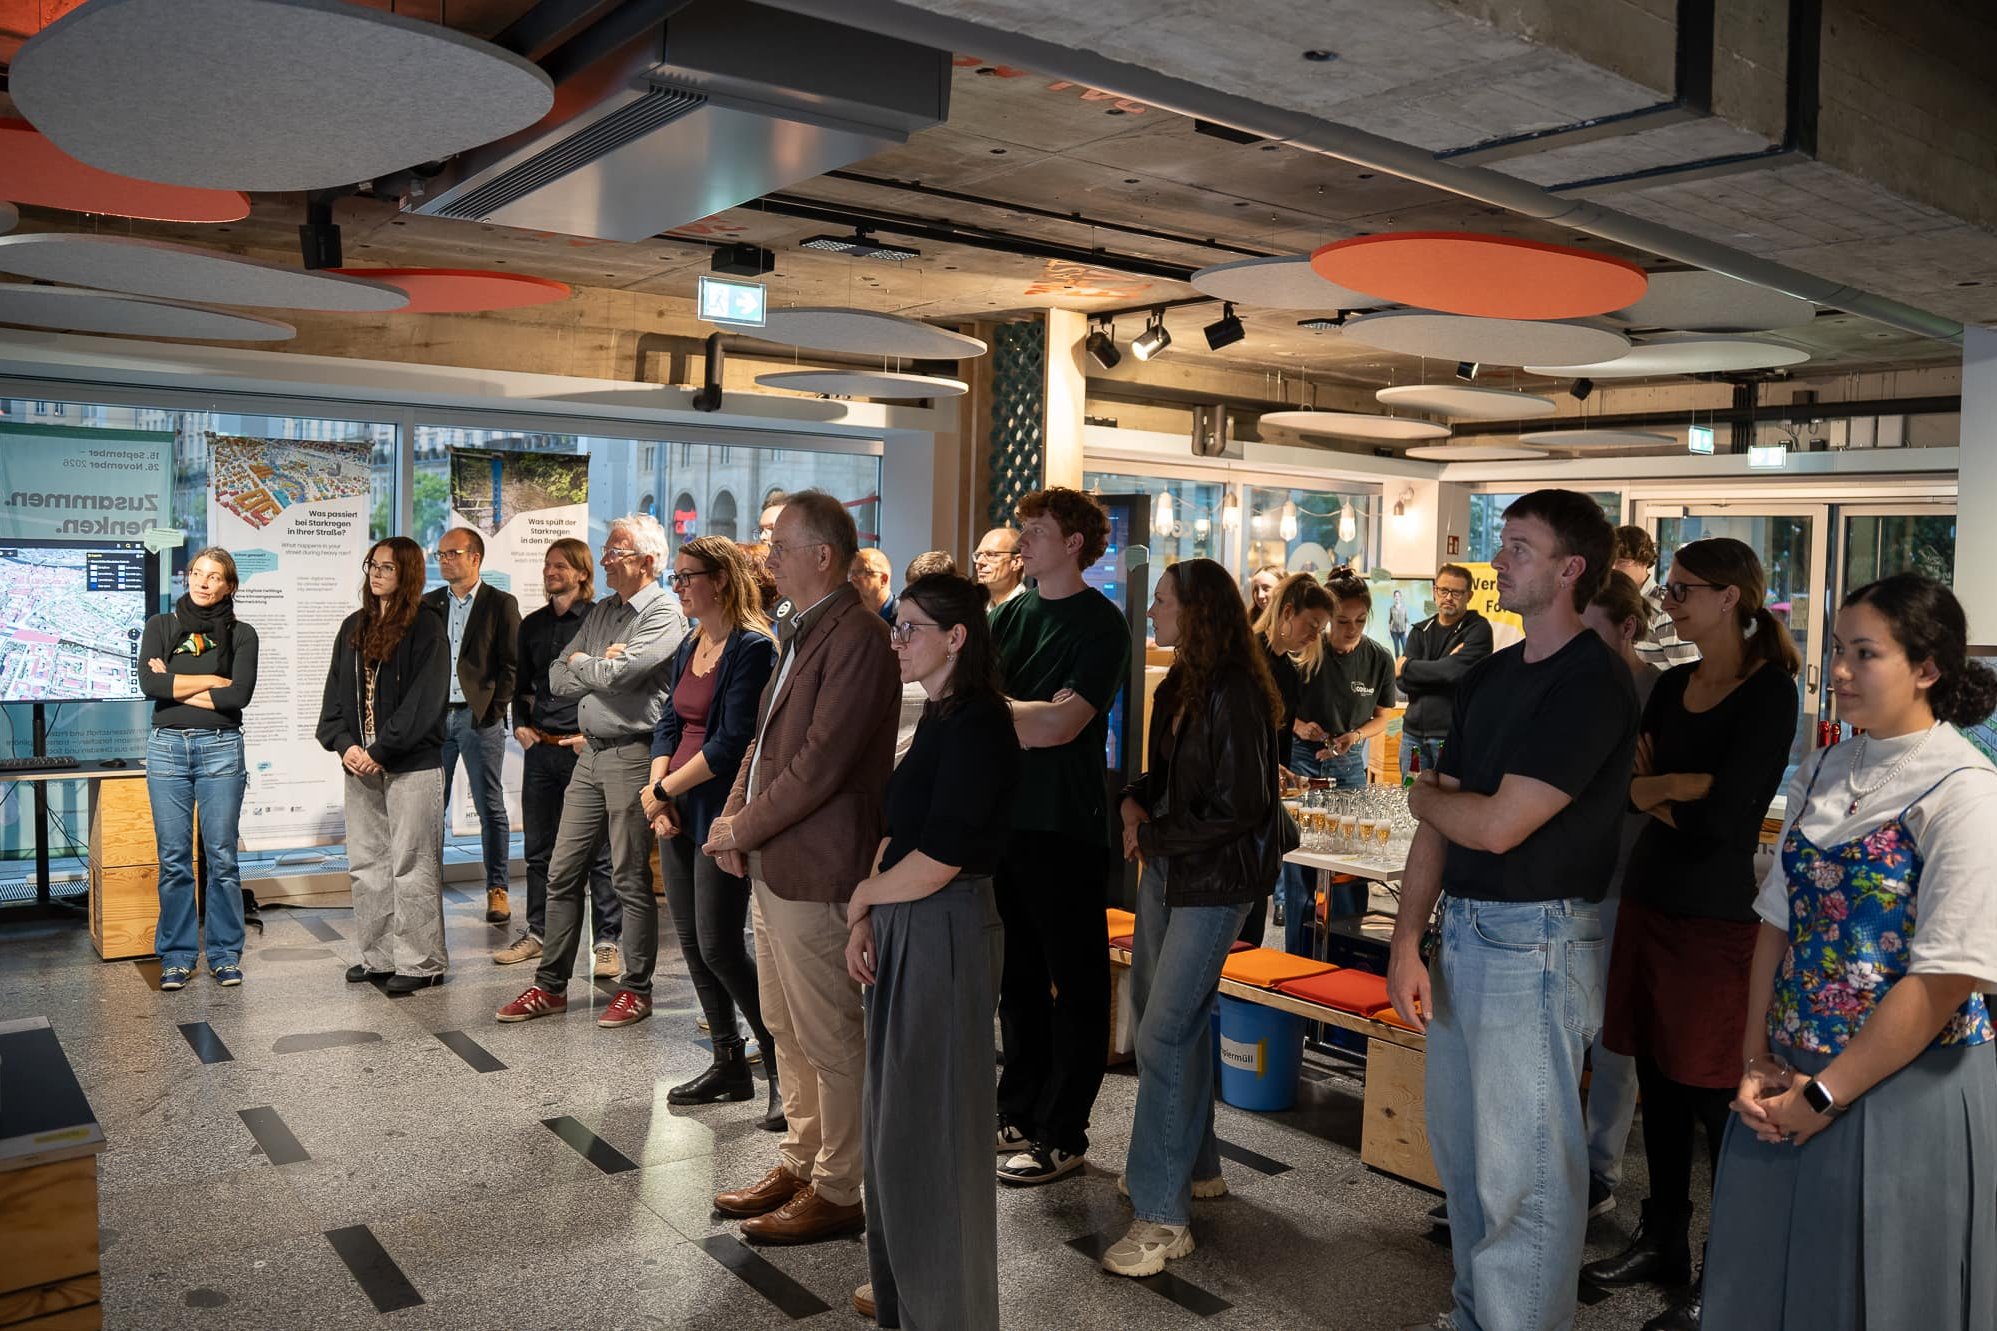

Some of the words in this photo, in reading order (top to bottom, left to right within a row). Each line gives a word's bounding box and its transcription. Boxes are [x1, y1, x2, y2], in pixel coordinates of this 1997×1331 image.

[327, 510, 358, 519] passiert
[308, 520, 351, 528] Starkregen
[545, 518, 564, 526] spült
[530, 528, 571, 537] Starkregen
